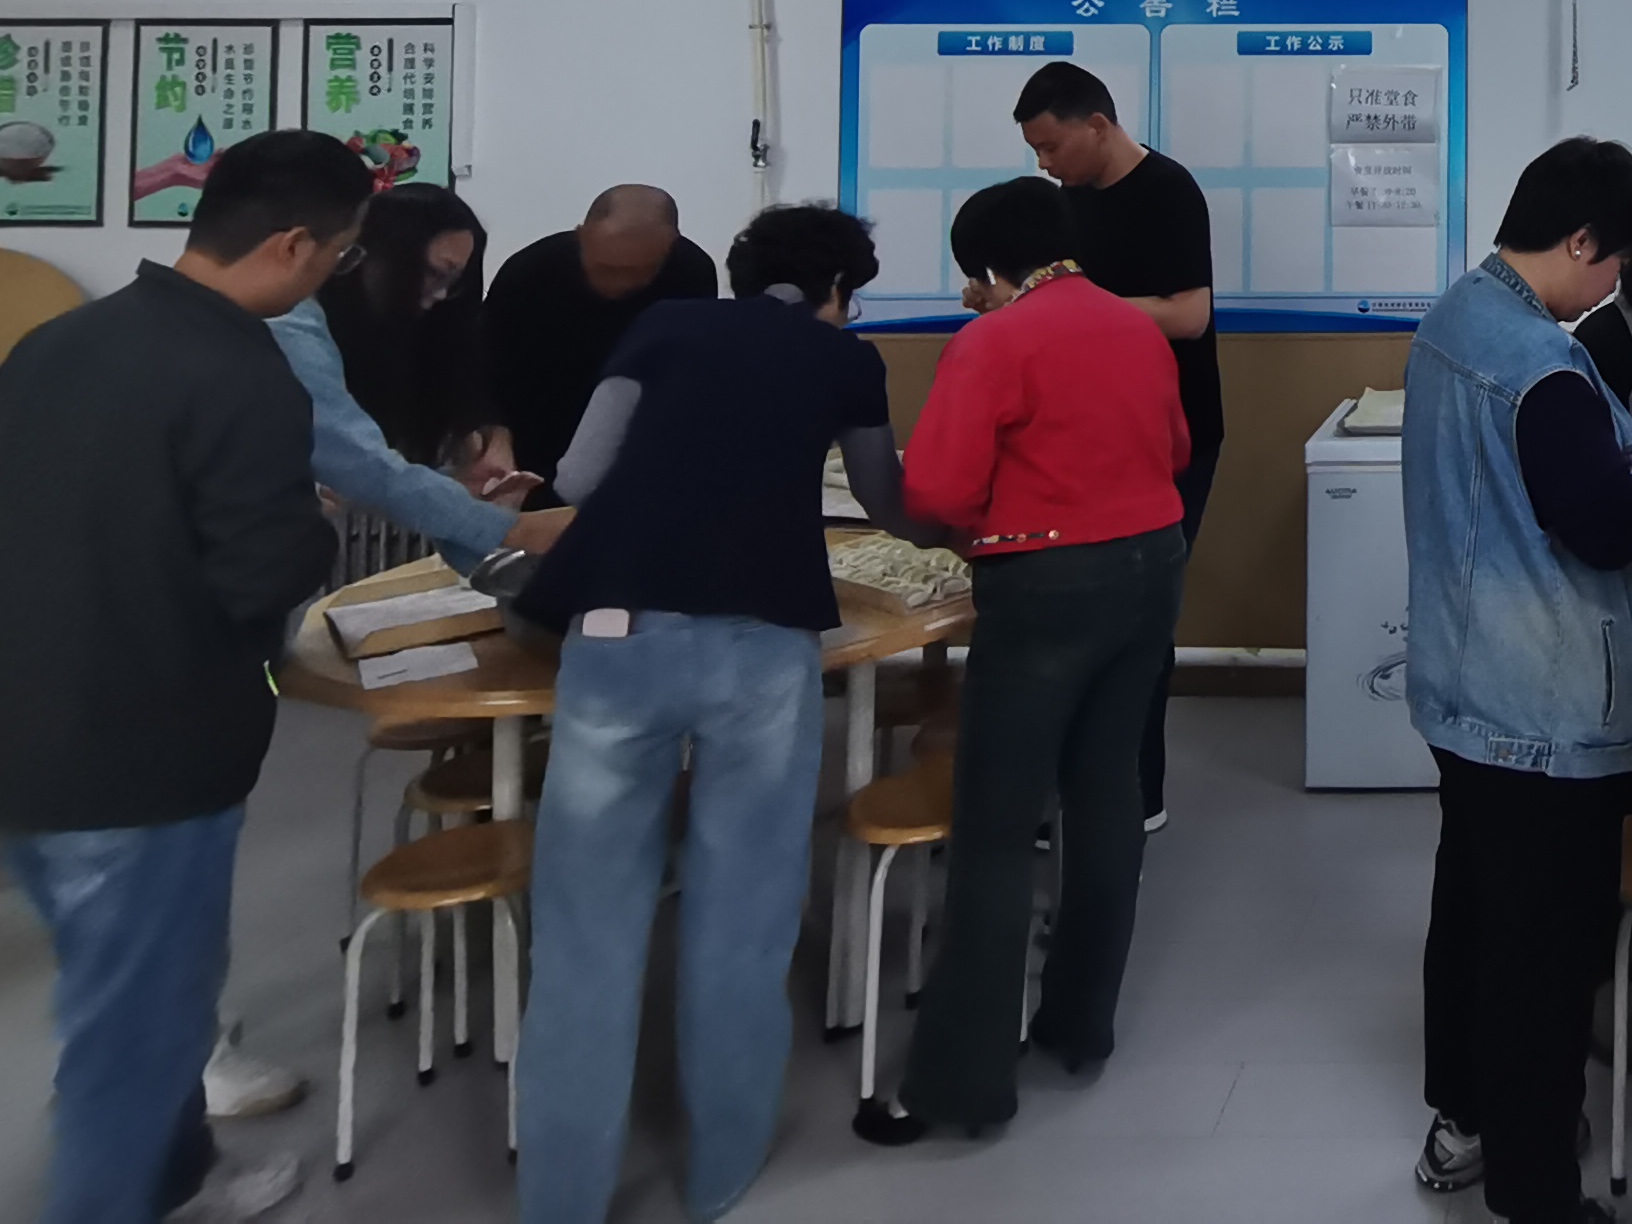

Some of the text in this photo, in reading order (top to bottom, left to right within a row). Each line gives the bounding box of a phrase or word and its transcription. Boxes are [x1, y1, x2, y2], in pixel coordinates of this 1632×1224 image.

[965, 35, 1047, 52] 工作制度
[1264, 35, 1346, 52] 工作公示
[155, 32, 189, 113] 节约
[325, 32, 362, 114] 营养
[1347, 88, 1419, 107] 只准堂食
[1346, 113, 1418, 131] 严禁外带
